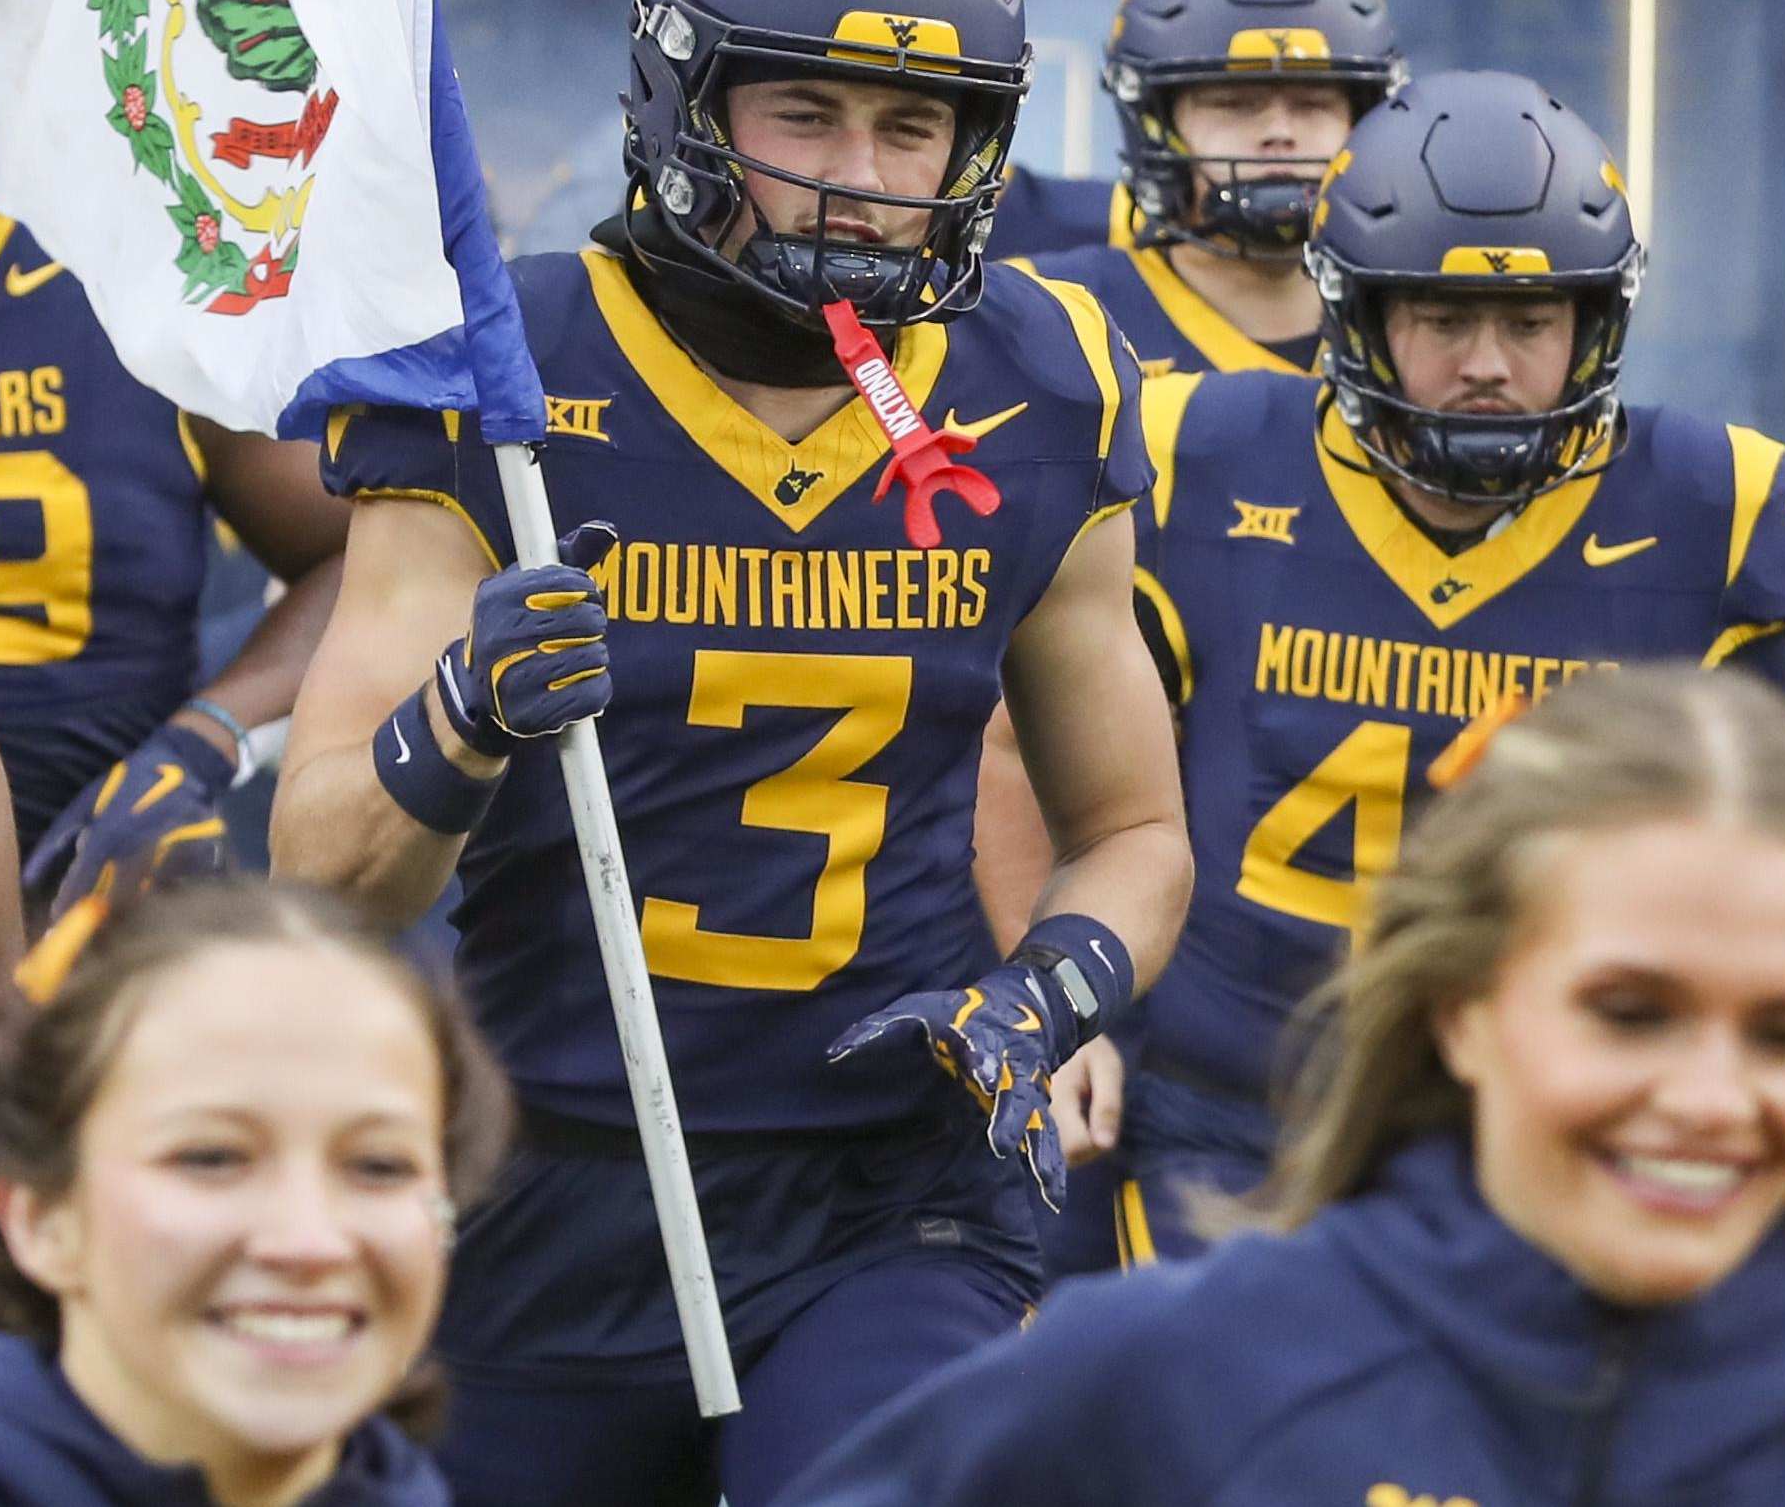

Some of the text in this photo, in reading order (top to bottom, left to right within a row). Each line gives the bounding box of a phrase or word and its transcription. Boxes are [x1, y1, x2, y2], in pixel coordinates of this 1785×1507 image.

[855, 357, 921, 441] NXTRND
[588, 539, 991, 631] MOUNTAINEERS
[1254, 621, 1621, 721] MOUNTAINEE
[639, 649, 913, 992] 3
